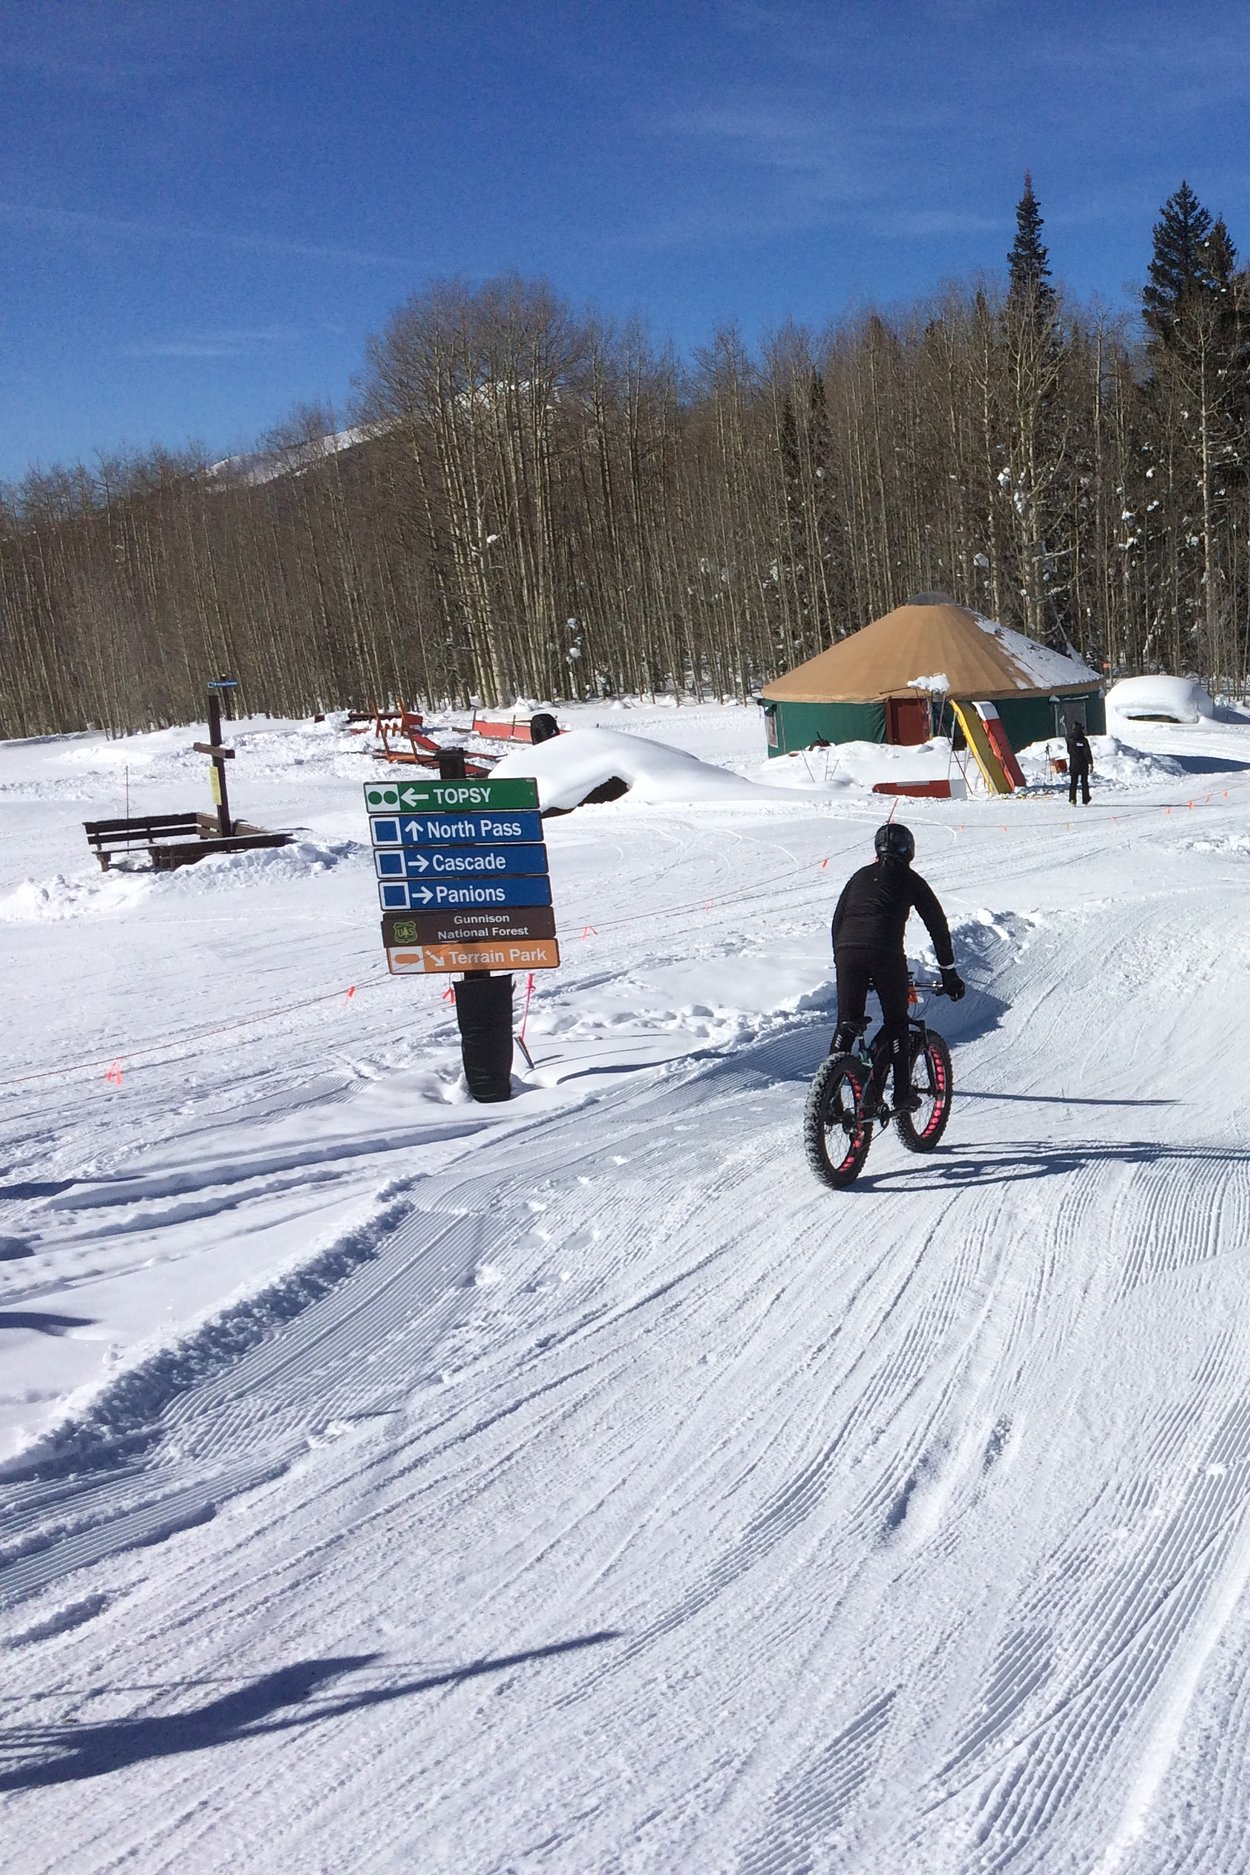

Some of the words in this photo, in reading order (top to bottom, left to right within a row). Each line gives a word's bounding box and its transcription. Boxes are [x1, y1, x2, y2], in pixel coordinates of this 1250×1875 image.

[433, 787, 491, 804] TOPSY
[427, 820, 475, 838] North
[481, 820, 521, 836] Pass
[432, 853, 506, 871] Cascade
[436, 885, 505, 903] Panions
[454, 914, 510, 924] Gunnison
[438, 930, 488, 939] National
[492, 927, 528, 936] Forest
[449, 950, 505, 964] Terrain
[509, 948, 547, 961] Park
